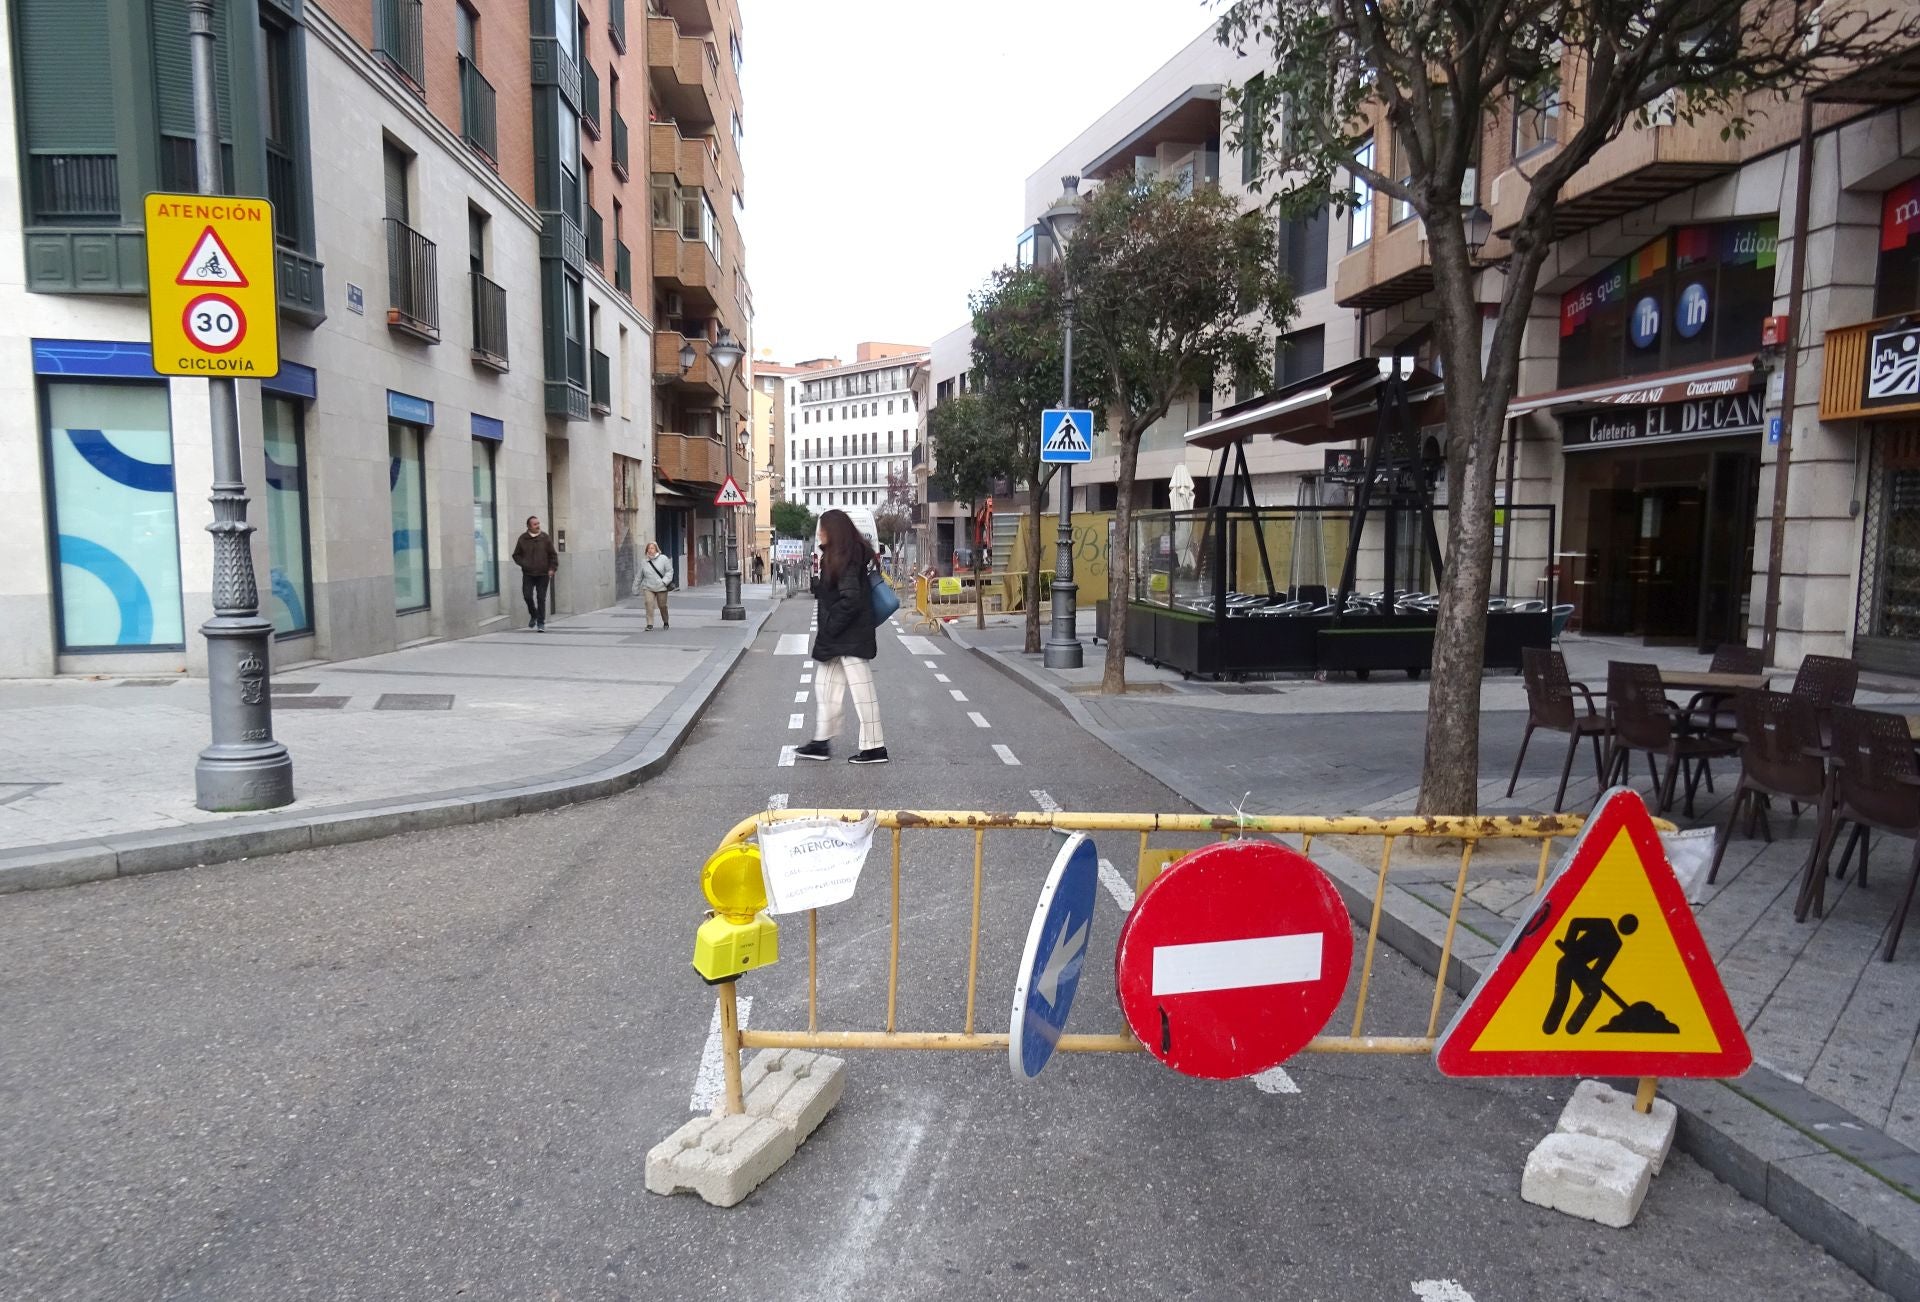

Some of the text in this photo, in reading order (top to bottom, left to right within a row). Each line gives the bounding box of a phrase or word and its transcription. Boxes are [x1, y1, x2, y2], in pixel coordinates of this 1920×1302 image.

[157, 203, 262, 222] ATENCIÓN
[1895, 199, 1920, 225] m
[1566, 274, 1622, 317] más que
[1687, 291, 1707, 325] ih
[196, 312, 234, 333] 30
[1640, 305, 1660, 337] ih
[178, 356, 255, 371] CICLOVÍA
[1687, 377, 1737, 397] Cruzcampo
[1645, 406, 1672, 436] EL
[1681, 393, 1765, 432] DECAN
